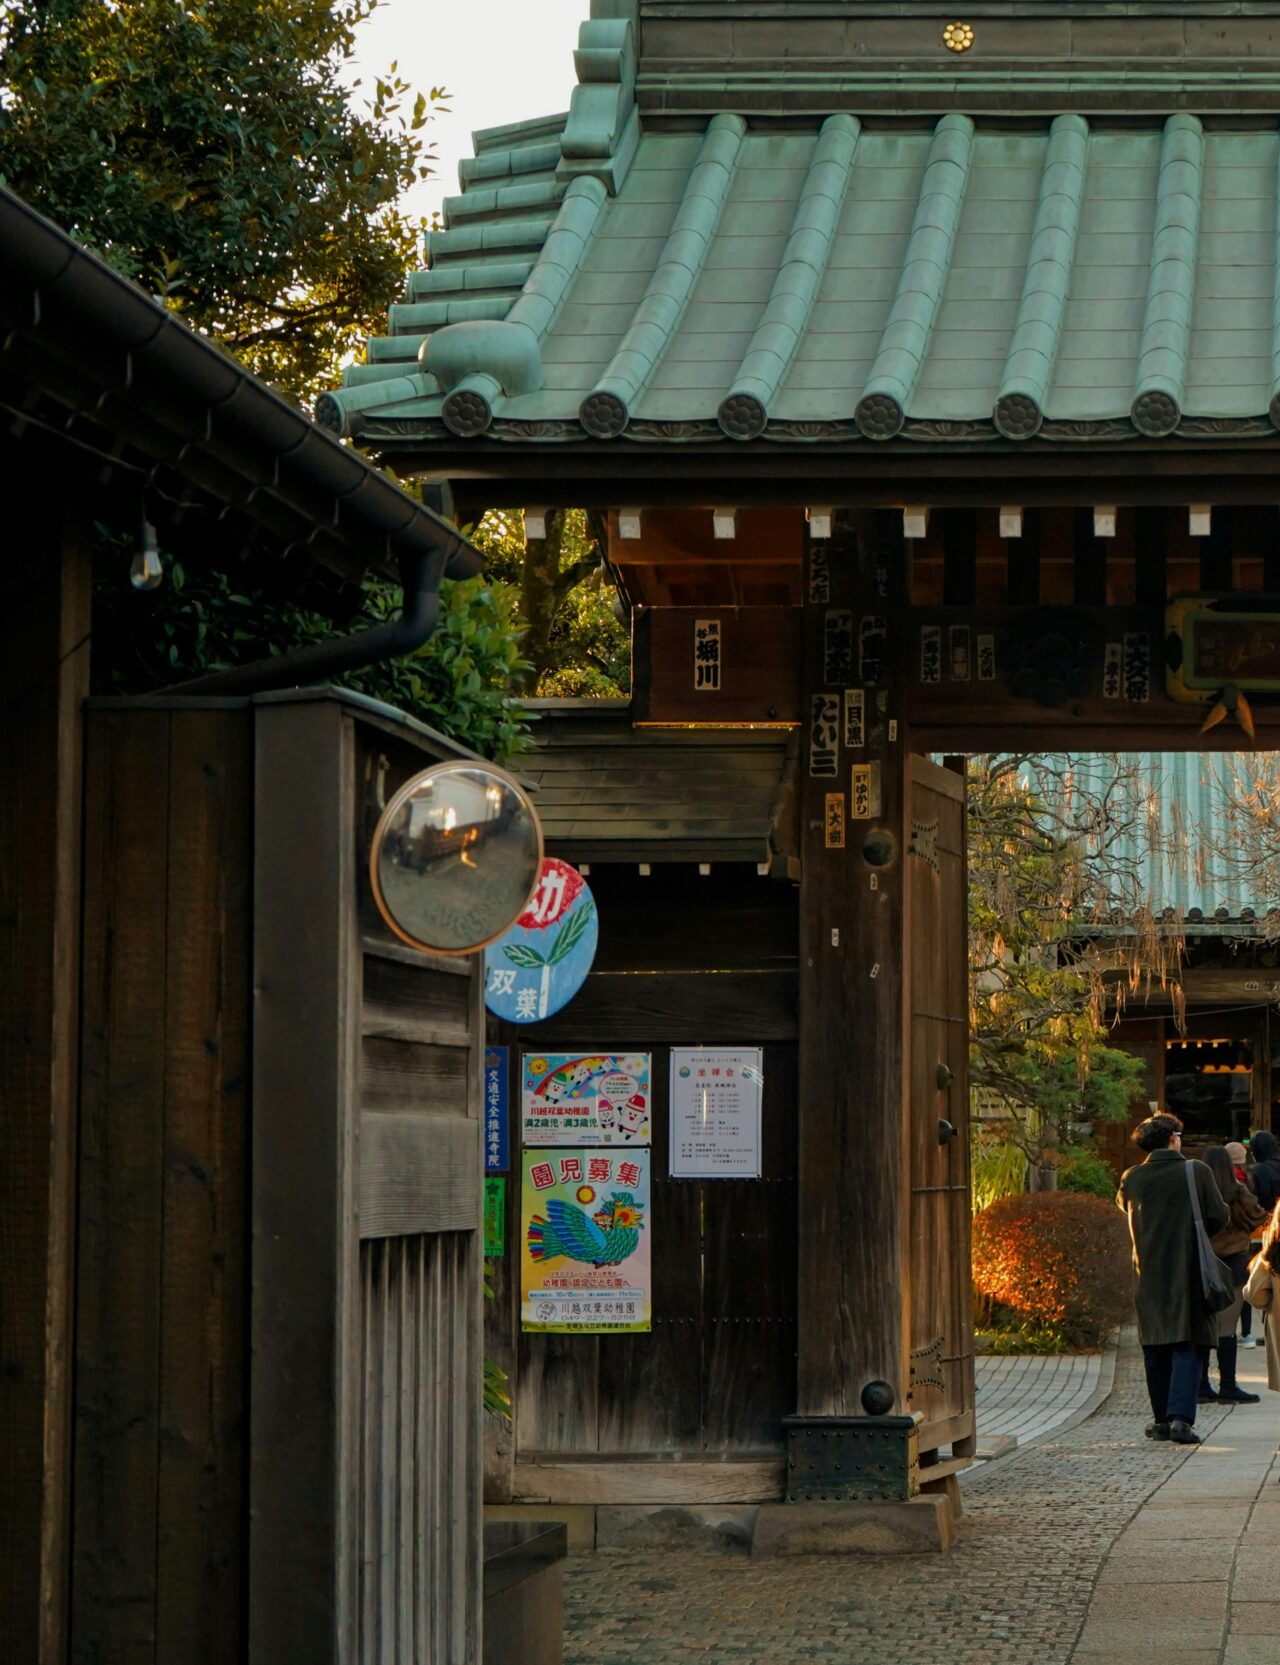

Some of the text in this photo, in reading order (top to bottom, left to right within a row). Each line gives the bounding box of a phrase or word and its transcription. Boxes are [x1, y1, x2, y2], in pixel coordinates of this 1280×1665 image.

[696, 639, 719, 688] 堀川
[810, 695, 837, 776] たい三
[847, 706, 863, 746] 目黒
[855, 783, 868, 816] ゆかり
[488, 967, 538, 1020] 双葉
[487, 1069, 501, 1167] 交通安全推進寺院
[524, 1118, 599, 1128] 満2歳児・満3歳児
[530, 1106, 590, 1116] 川越双葉幼稚園
[530, 1157, 641, 1189] 園児募集
[561, 1302, 636, 1315] 川越双葉幼稚園
